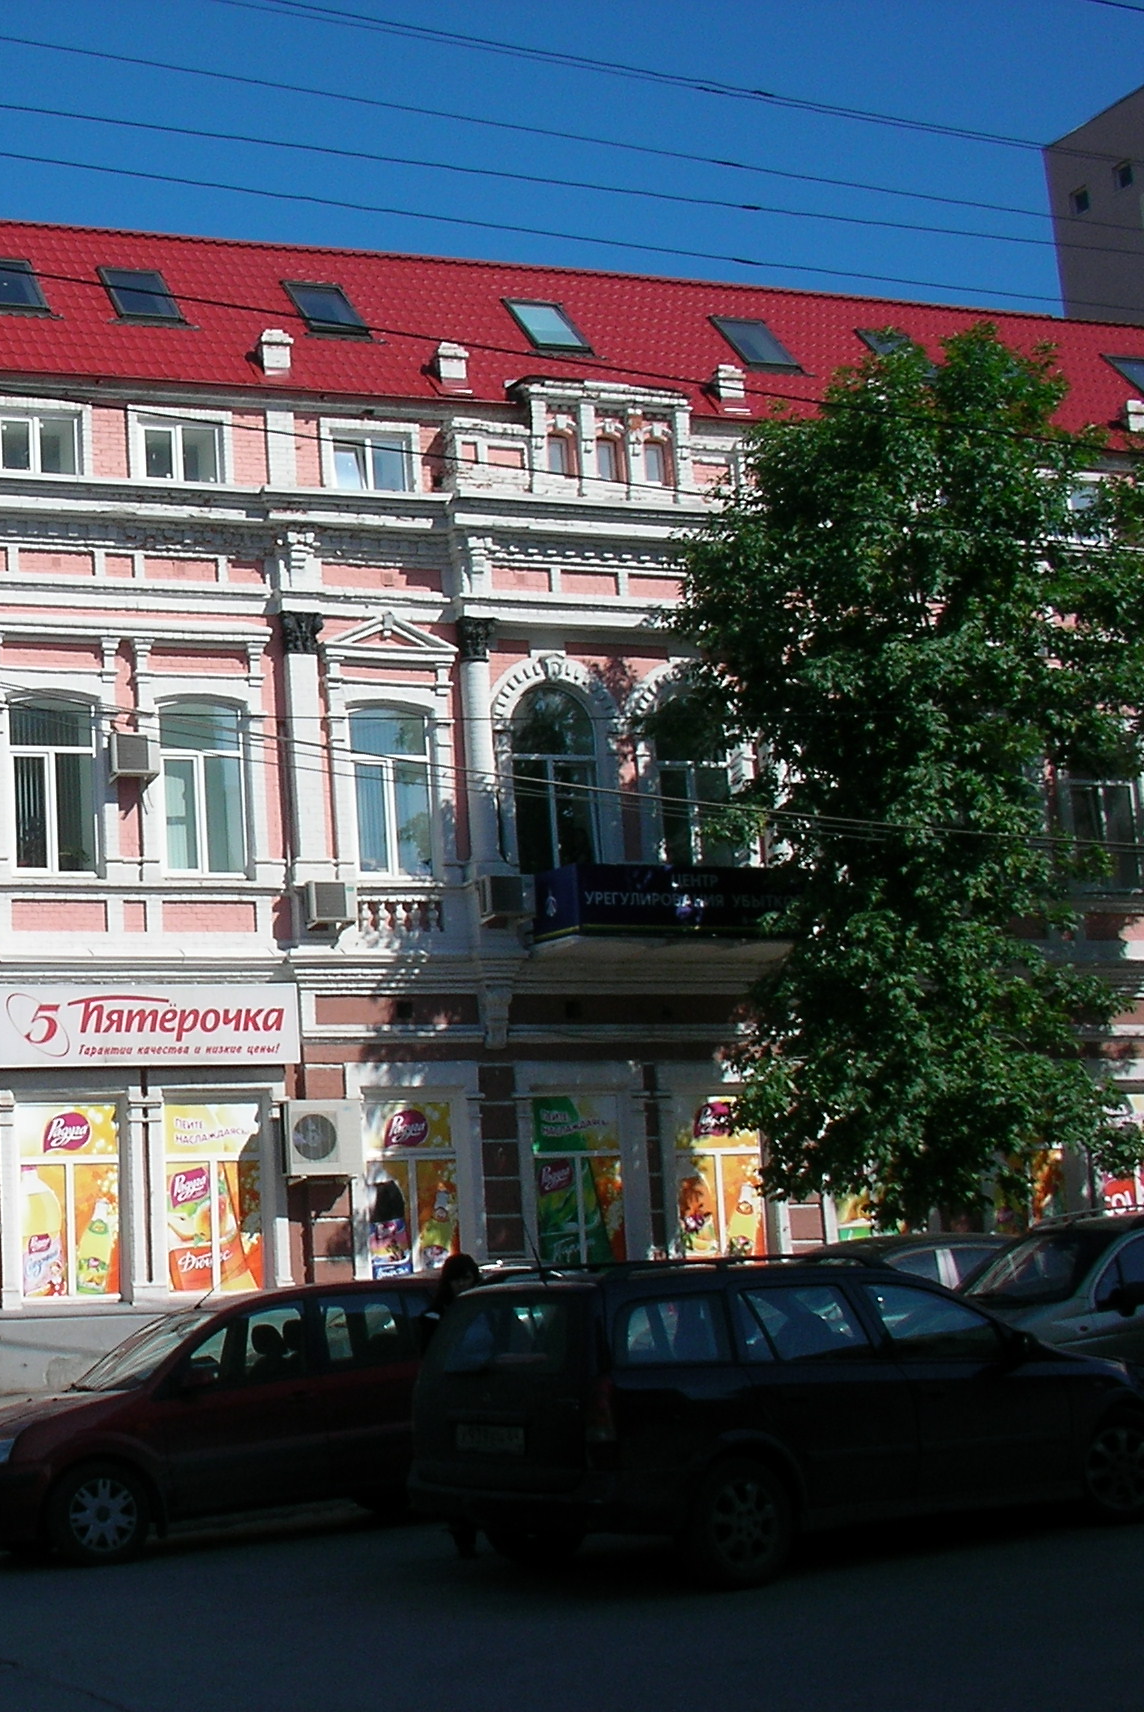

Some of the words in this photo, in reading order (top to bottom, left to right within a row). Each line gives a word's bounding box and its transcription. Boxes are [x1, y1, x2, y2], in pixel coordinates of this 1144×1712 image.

[671, 874, 719, 889] ЦЕНТР
[24, 1004, 61, 1044] 5
[68, 994, 284, 1042] Пятёрочка
[137, 1046, 189, 1055] качества
[194, 1046, 200, 1054] и
[206, 1045, 242, 1054] низкие
[247, 1043, 280, 1056] цены!
[47, 1117, 89, 1147] Радуга
